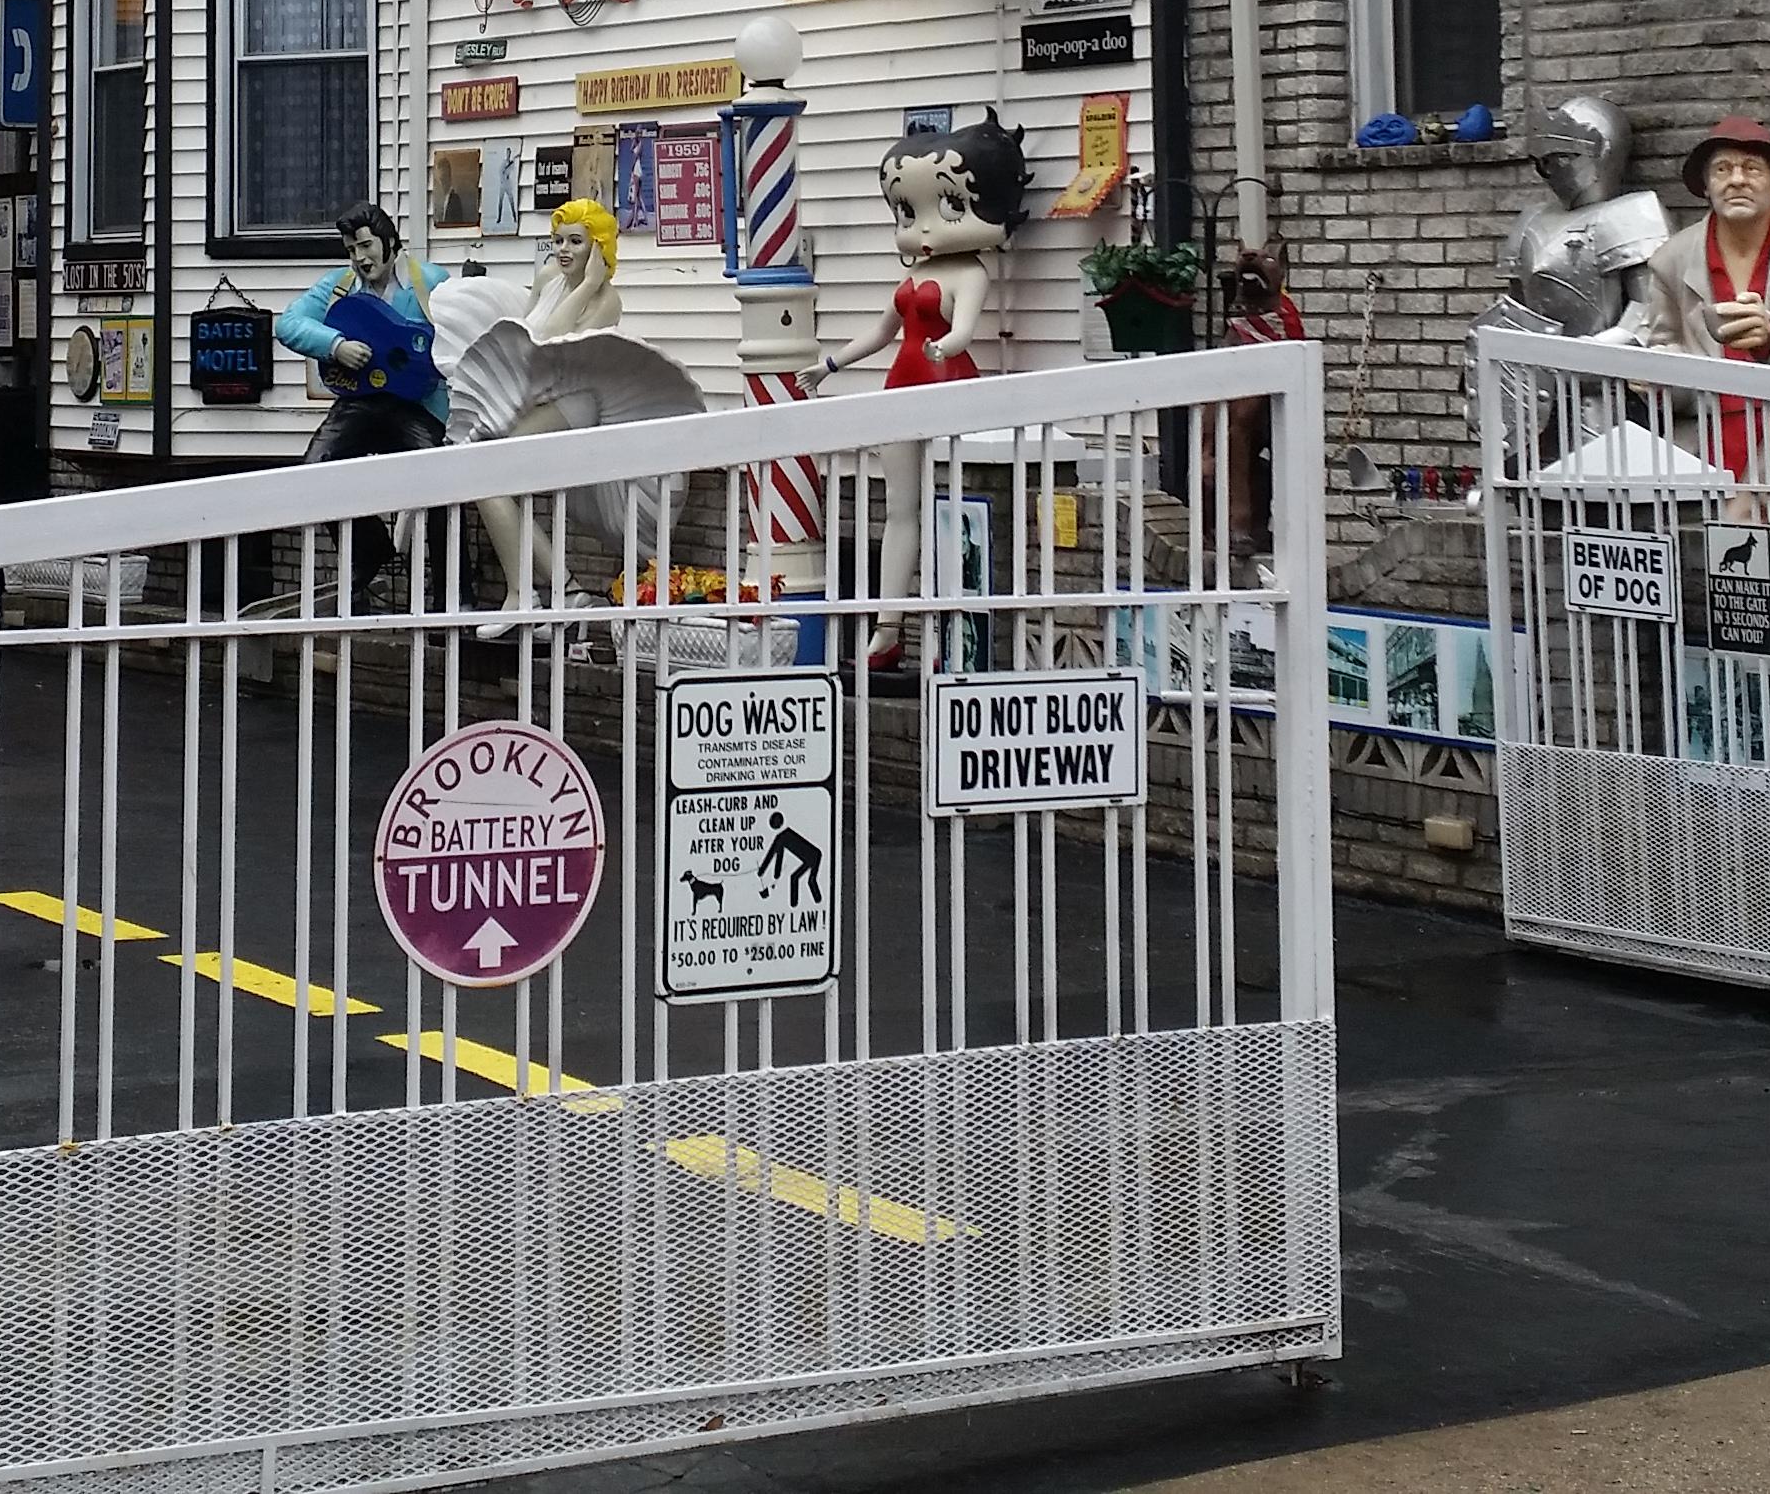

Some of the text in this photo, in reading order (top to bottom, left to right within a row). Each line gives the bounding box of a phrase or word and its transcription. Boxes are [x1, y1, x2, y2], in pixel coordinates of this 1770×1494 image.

[1026, 30, 1127, 62] Boop-oop-a doo
[579, 65, 733, 106] "HAPPY BIRTHDAY MR. PRESIDENT"
[471, 86, 483, 112] BE
[661, 143, 705, 156] "1959"
[538, 241, 553, 252] LOST
[66, 263, 141, 289] LOST IN THE 50'S
[197, 322, 254, 339] BATES
[196, 349, 258, 371] MOTEL
[324, 370, 358, 391] Elvis
[1574, 542, 1663, 575] BEWARE
[1579, 574, 1661, 606] OF DOG
[1709, 578, 1770, 597] I CAN MAKE IT
[1714, 594, 1768, 612] TO THE GATE
[1714, 610, 1770, 628] IN 3 SECONDS
[1721, 626, 1764, 644] CAN YOU?
[678, 696, 826, 738] DOG WASTE
[950, 692, 1125, 738] DO NOT BLOCK
[698, 739, 806, 753] TRANSMITS DISEASE
[698, 754, 806, 769] CONTAMINATES OUR
[961, 744, 1114, 790] DRIVEWAY
[706, 769, 797, 783] DRINKING WATER
[391, 740, 590, 849] BROOKLYN
[676, 794, 778, 815] LEASH-CURB AND
[431, 814, 554, 852] BATTERY
[699, 816, 756, 833] CLEAN UP
[690, 835, 764, 854] AFTER YOUR
[713, 857, 740, 873] DOG
[398, 856, 579, 914] TUNNEL
[674, 918, 697, 942] IT'S
[702, 914, 763, 940] REQUIRED
[768, 913, 785, 935] BY
[671, 941, 825, 968] $50.00 TO $250.00 FINE
